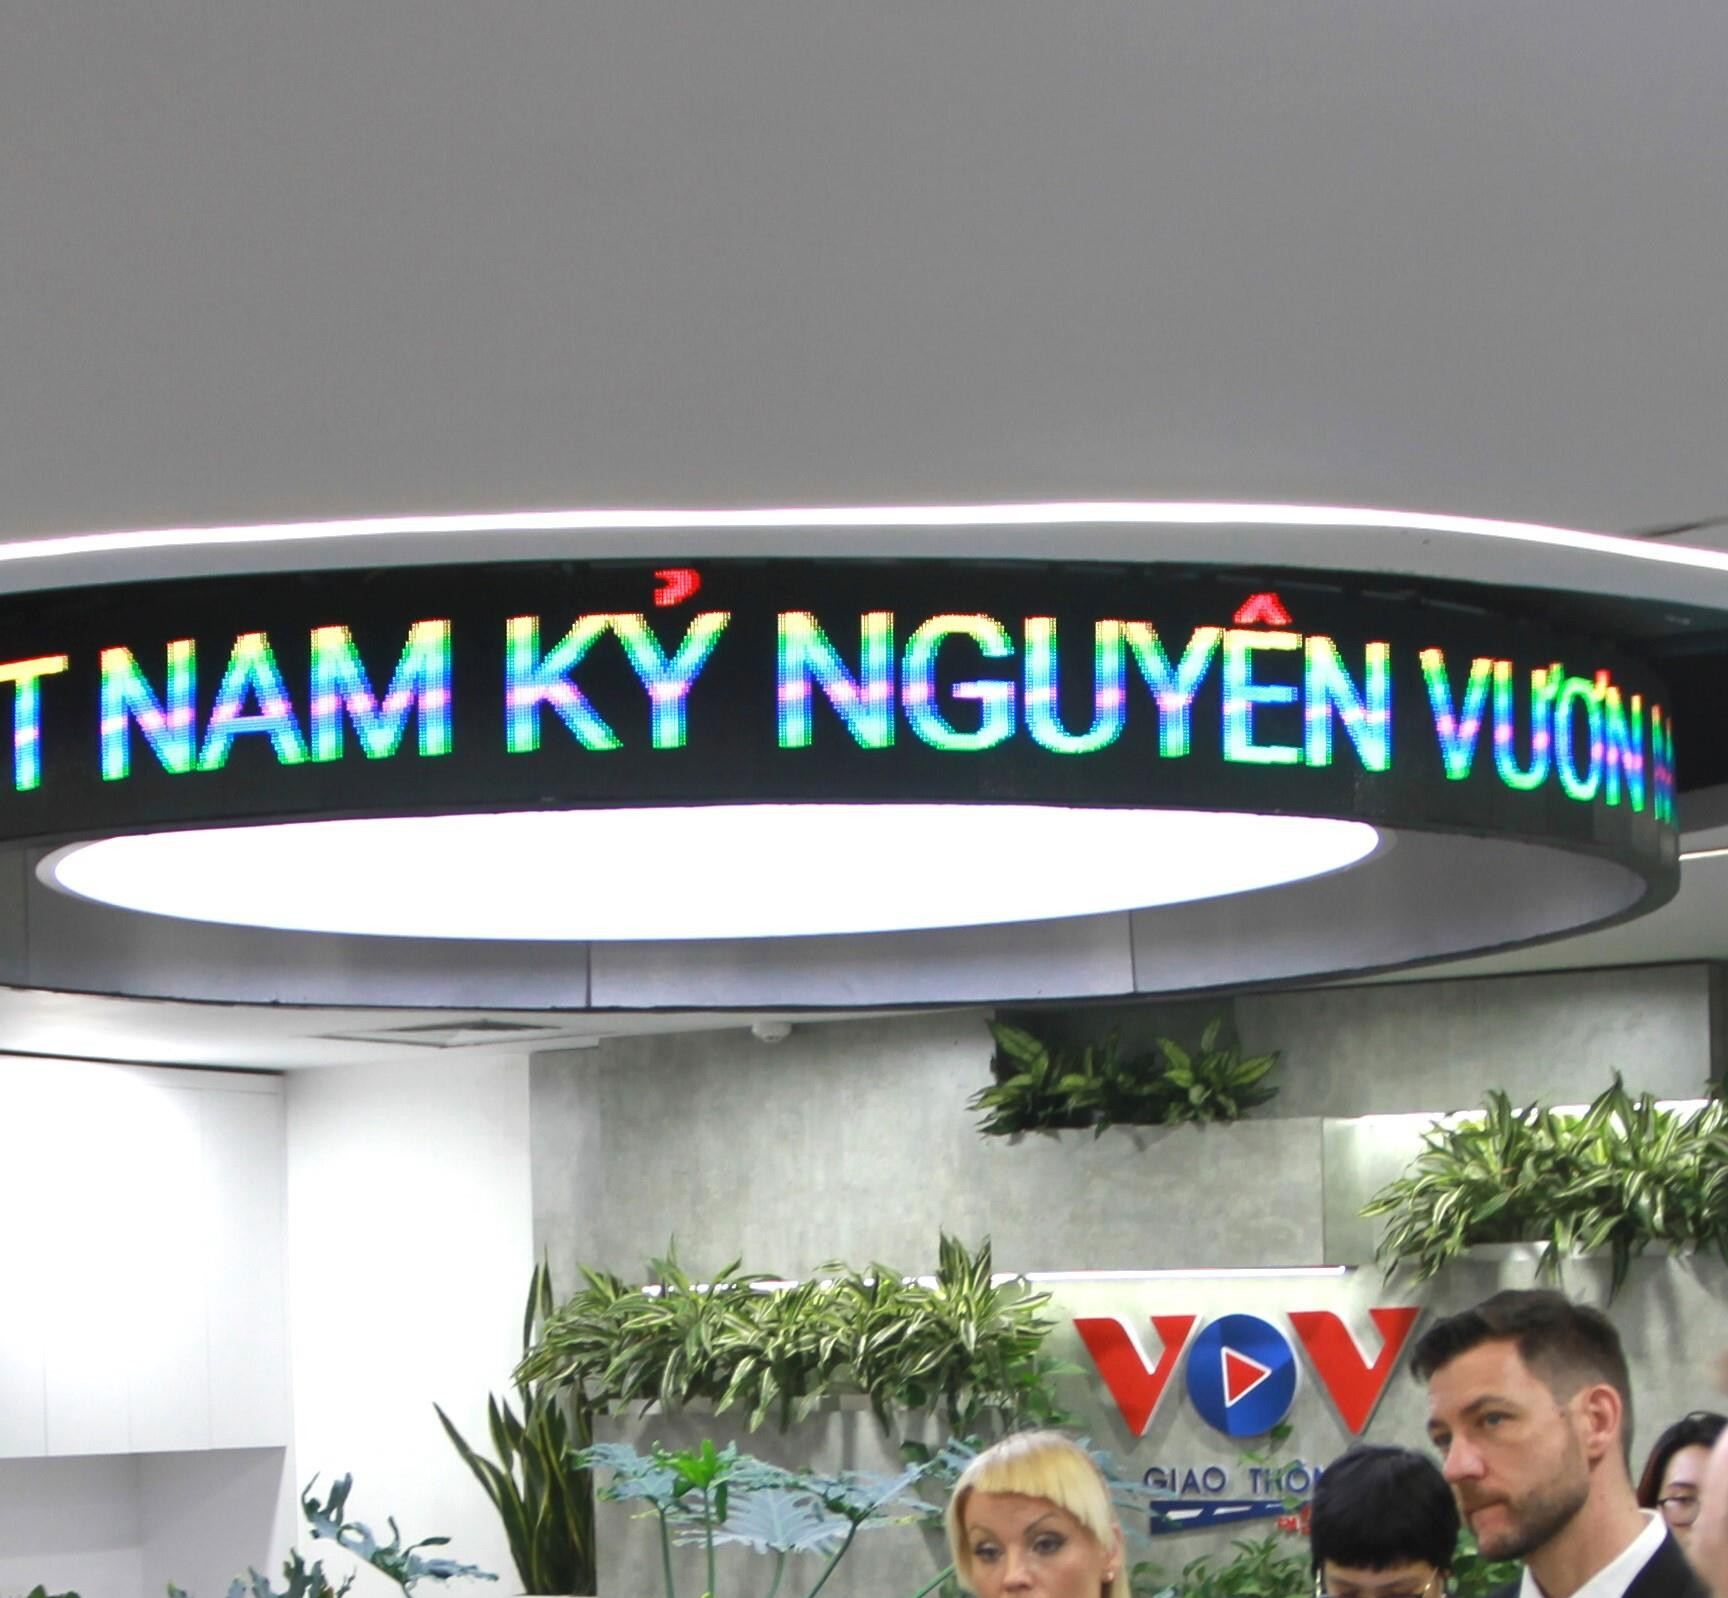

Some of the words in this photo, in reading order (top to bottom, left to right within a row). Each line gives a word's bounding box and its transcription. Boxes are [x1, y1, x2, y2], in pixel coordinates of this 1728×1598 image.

[99, 619, 452, 781] NAM
[504, 569, 730, 753] KỶ
[776, 593, 1393, 772] NGUYÊN
[1419, 648, 1645, 812] VƯƠN
[1073, 1306, 1420, 1438] VOV
[1144, 1466, 1227, 1494] GIAO
